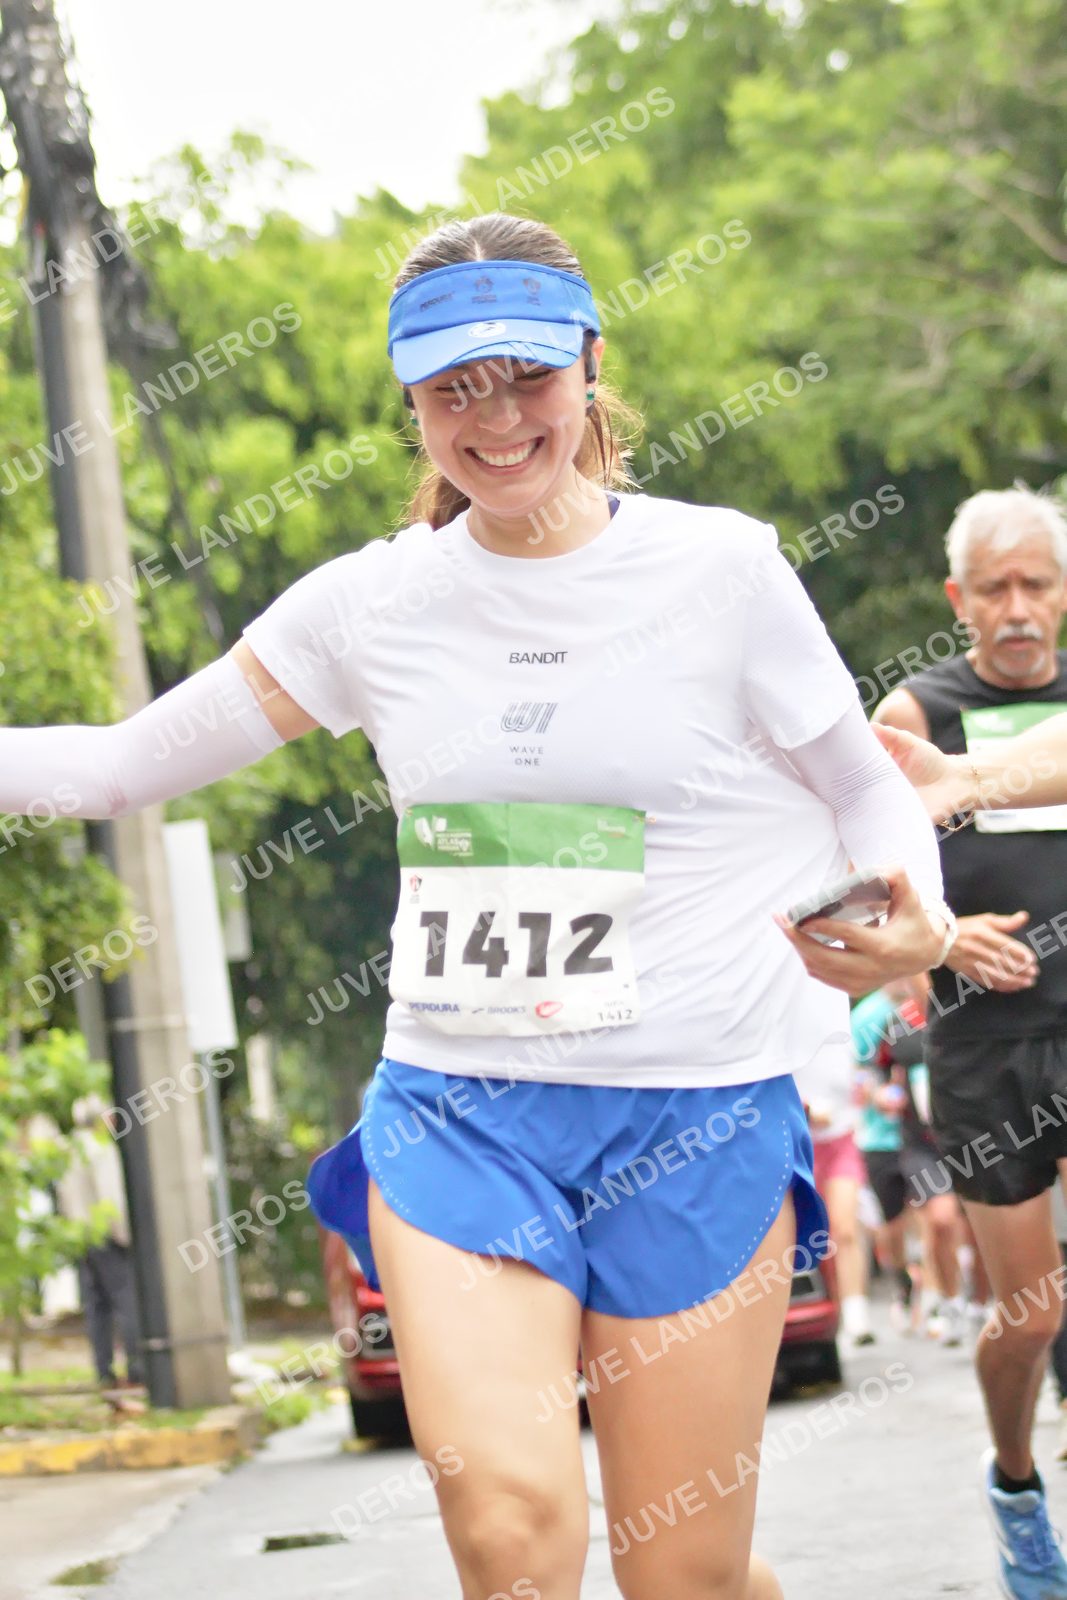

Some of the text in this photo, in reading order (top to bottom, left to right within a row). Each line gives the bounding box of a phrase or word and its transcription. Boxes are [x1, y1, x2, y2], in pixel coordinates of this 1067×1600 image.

[509, 651, 568, 664] BANDIT
[509, 745, 544, 754] WAVE
[514, 758, 541, 766] ONE
[420, 911, 614, 978] 1412
[408, 1002, 460, 1013] PERDURA
[598, 1009, 633, 1022] 1412
